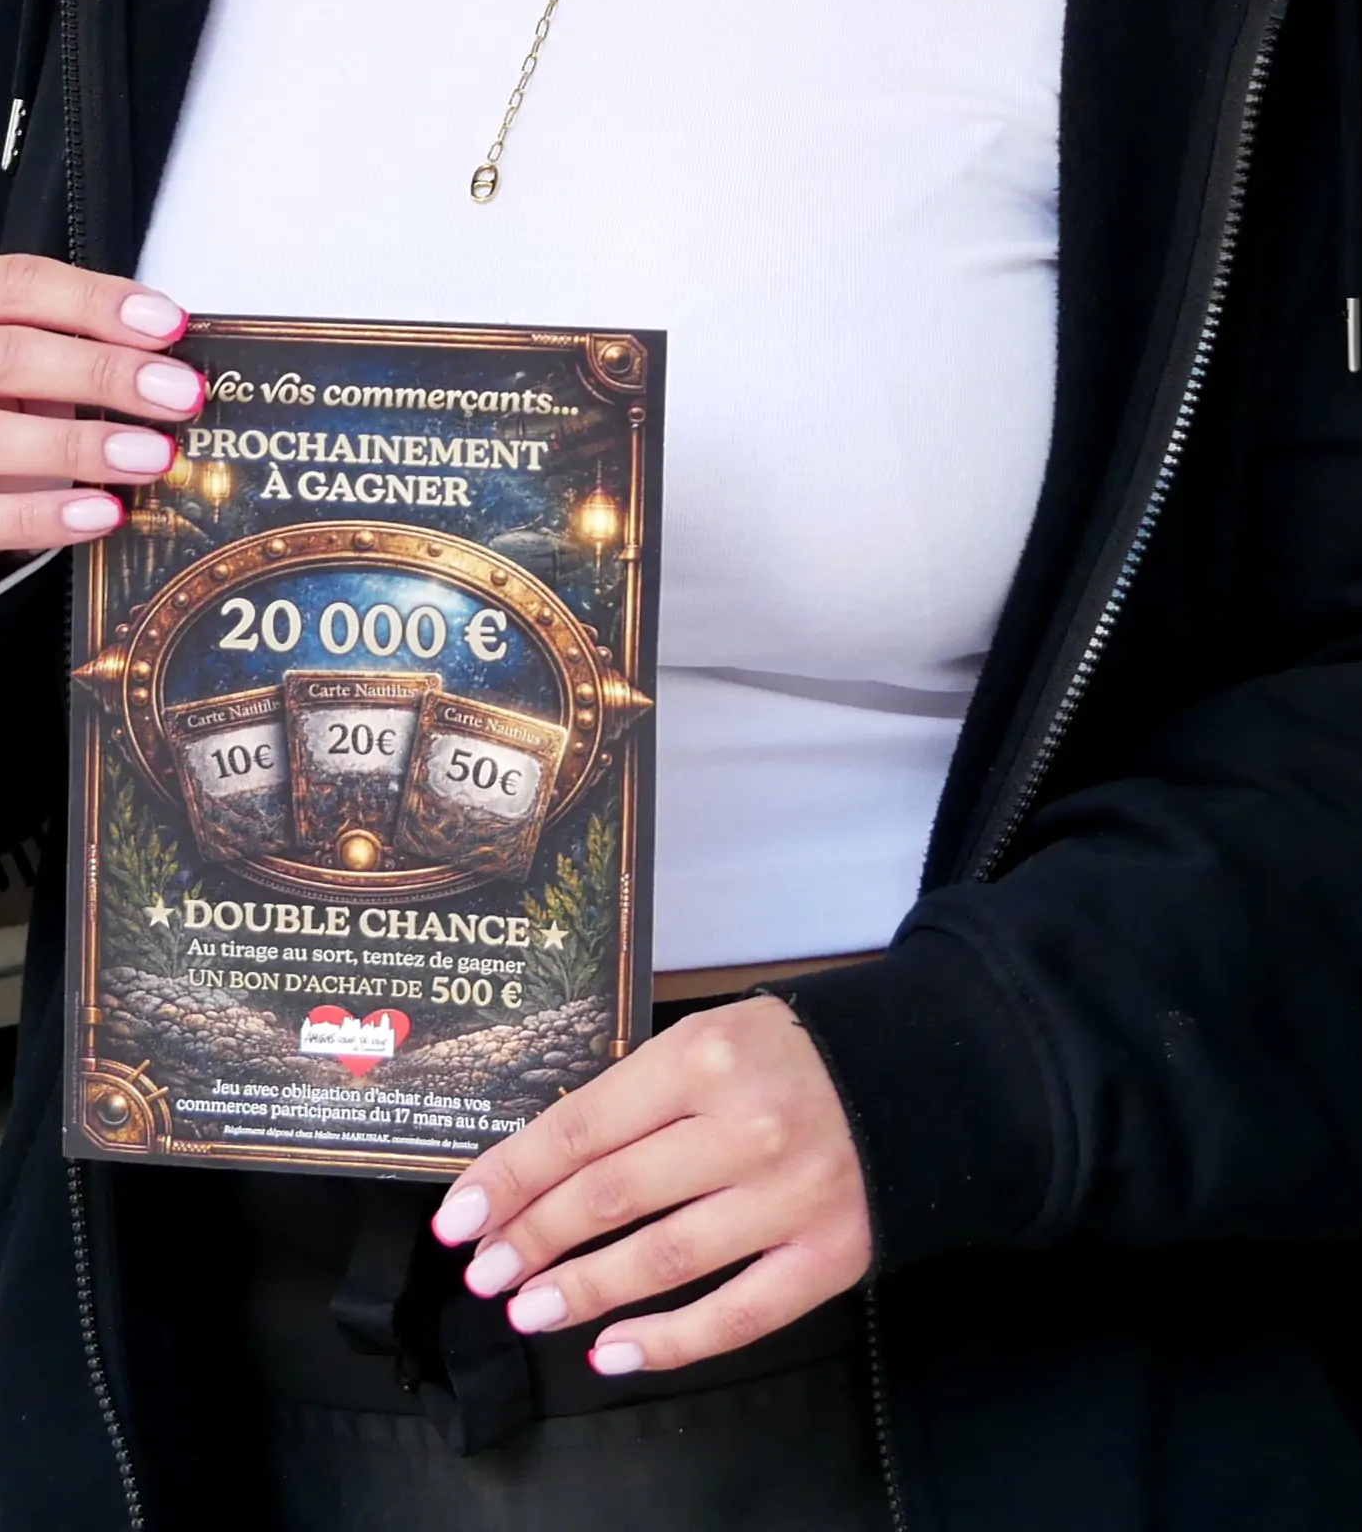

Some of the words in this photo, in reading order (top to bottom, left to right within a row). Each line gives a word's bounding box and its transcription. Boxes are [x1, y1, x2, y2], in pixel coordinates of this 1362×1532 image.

[205, 371, 254, 403] vec
[261, 372, 315, 406] vos
[323, 384, 579, 418] commerçants...
[186, 428, 549, 470] PROCHAINEMENT
[260, 463, 293, 500] À
[298, 470, 472, 507] GAGNER
[219, 598, 302, 652] 20
[319, 602, 447, 658] 000
[464, 608, 508, 661] €
[308, 682, 350, 699] Carte
[187, 709, 226, 729] Carte
[444, 707, 484, 728] Carte
[327, 723, 397, 756] 20€
[211, 743, 275, 779] 10€
[446, 748, 523, 796] 50€
[184, 899, 351, 938] DOUBLE
[359, 908, 531, 948] CHANCE
[187, 937, 216, 956] Au
[221, 939, 279, 963] tirage
[282, 945, 308, 962] au
[312, 944, 359, 966] sort,
[362, 950, 426, 969] tentez
[429, 950, 454, 969] de
[458, 956, 526, 977] gagner
[188, 968, 225, 988] UN
[229, 970, 281, 992] BON
[285, 973, 387, 998] D'ACHAT
[391, 979, 423, 999] DE
[430, 976, 494, 1006] 500
[500, 980, 523, 1009] €
[176, 1098, 268, 1114] commerces
[271, 1101, 367, 1121] participants
[369, 1106, 391, 1122] du
[394, 1108, 410, 1124] 17
[413, 1112, 452, 1128] mars
[455, 1115, 475, 1129] au
[478, 1114, 489, 1130] 6
[212, 1079, 240, 1095] Jeu
[243, 1083, 279, 1097] avec
[282, 1082, 361, 1102] obligation
[364, 1087, 422, 1106] d'achat
[423, 1092, 461, 1109] dans
[465, 1099, 491, 1112] vos
